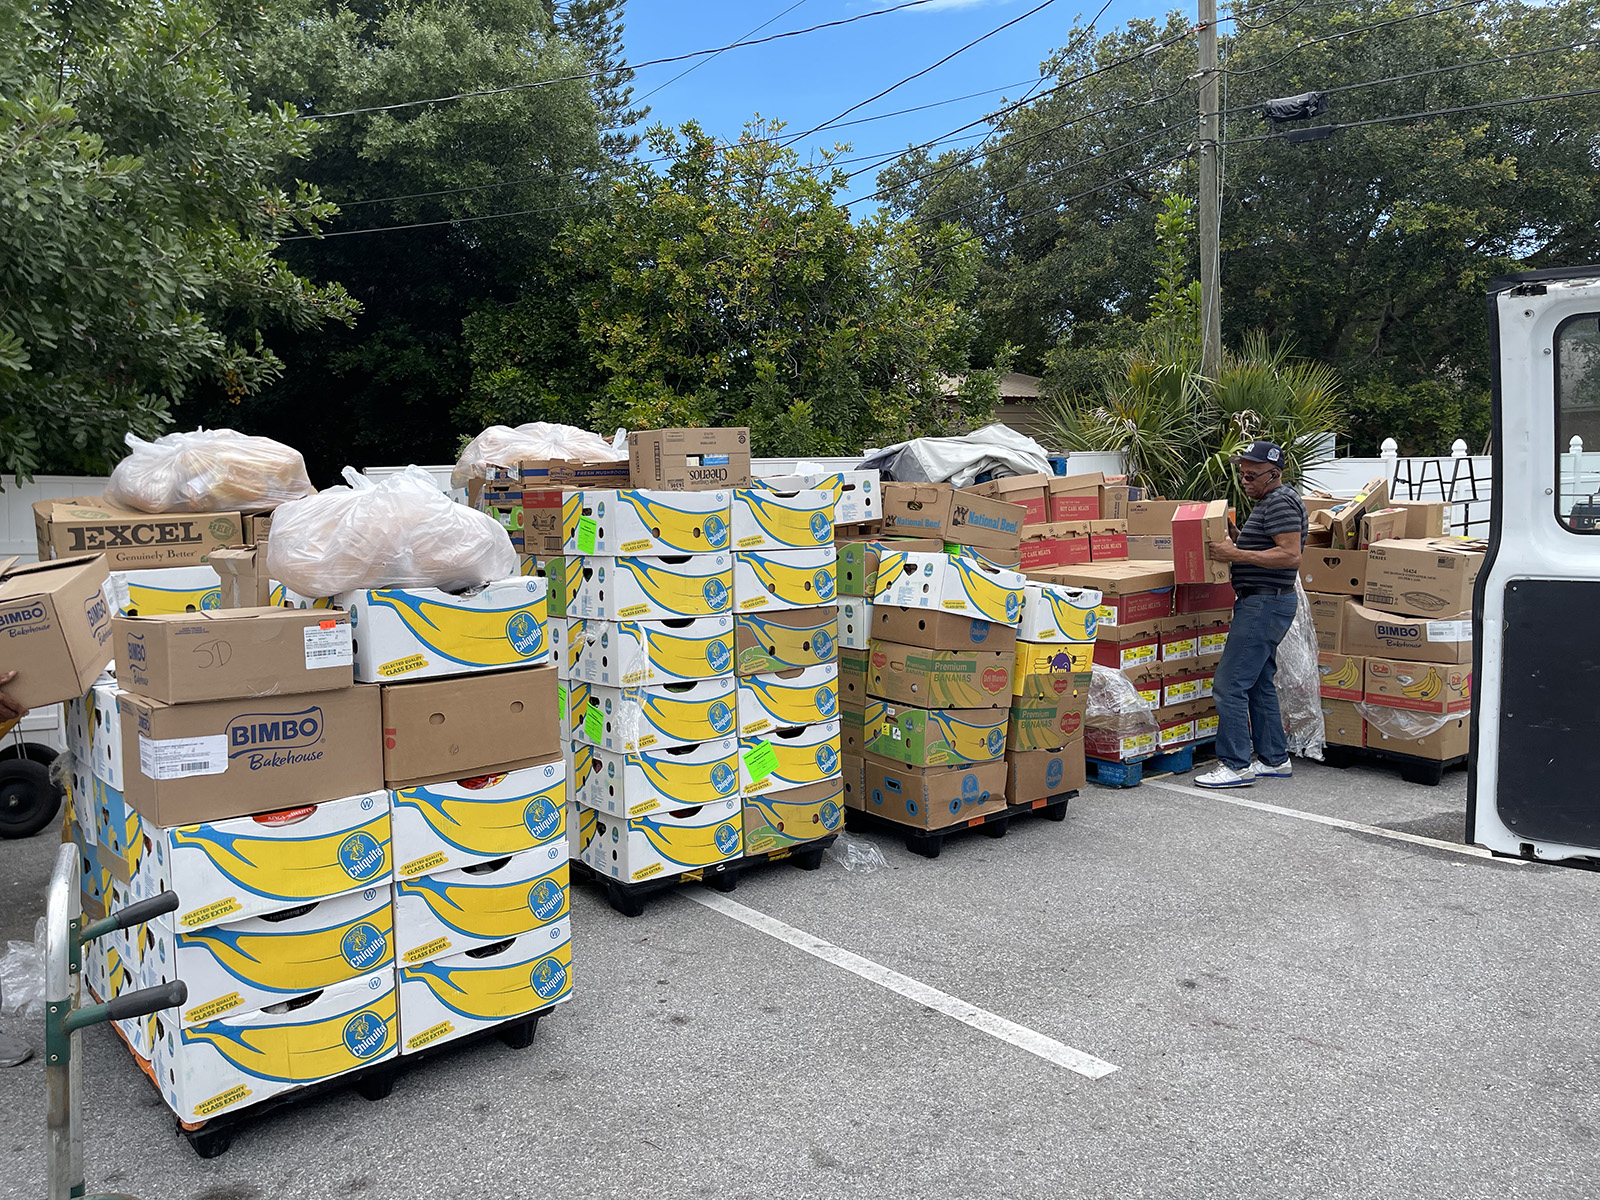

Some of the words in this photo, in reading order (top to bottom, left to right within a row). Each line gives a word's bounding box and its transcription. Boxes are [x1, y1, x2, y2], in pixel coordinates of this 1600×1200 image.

[896, 516, 924, 527] National
[925, 518, 941, 528] Beef
[967, 511, 1000, 529] National
[1000, 518, 1018, 533] Beef
[67, 522, 203, 551] EXCEL
[116, 551, 164, 562] Genuinely
[167, 550, 196, 559] Better
[8, 625, 50, 638] Bakehouse
[514, 626, 542, 653] Chiquita
[1377, 625, 1418, 637] BIMBO
[385, 666, 405, 676] CLASS
[405, 661, 424, 671] EXTRA
[934, 661, 967, 671] Premium
[1373, 664, 1389, 672] Dole
[933, 673, 971, 683] BANANAS
[1021, 720, 1052, 729] BANANAS
[1022, 710, 1050, 718] Premium
[232, 718, 318, 747] BIMBO
[248, 750, 323, 770] Bakehouse
[530, 810, 560, 838] Chiquita
[348, 846, 384, 879] Chiquita
[406, 864, 425, 875] CLASS
[425, 857, 444, 867] EXTRA
[184, 908, 209, 921] SELECTED
[210, 899, 232, 912] QUALITY
[188, 913, 211, 926] CLASS
[211, 905, 234, 917] EXTRA
[535, 890, 564, 920] Chiquita
[349, 936, 386, 969] Chiquita
[410, 951, 429, 962] CLASS
[429, 943, 447, 954] EXTRA
[537, 967, 567, 998] Chiquita
[190, 1003, 215, 1016] SELECTED
[215, 995, 238, 1007] QUALITY
[193, 1008, 217, 1022] CLASS
[217, 1000, 239, 1012] EXTRA
[351, 1024, 388, 1057] Chiquita
[412, 1036, 430, 1049] CLASS
[430, 1028, 448, 1039] EXTRA
[198, 1096, 223, 1109] SELECTED
[223, 1086, 245, 1099] QUALITY
[202, 1101, 224, 1115] CLASS
[224, 1091, 246, 1104] EXTRA
